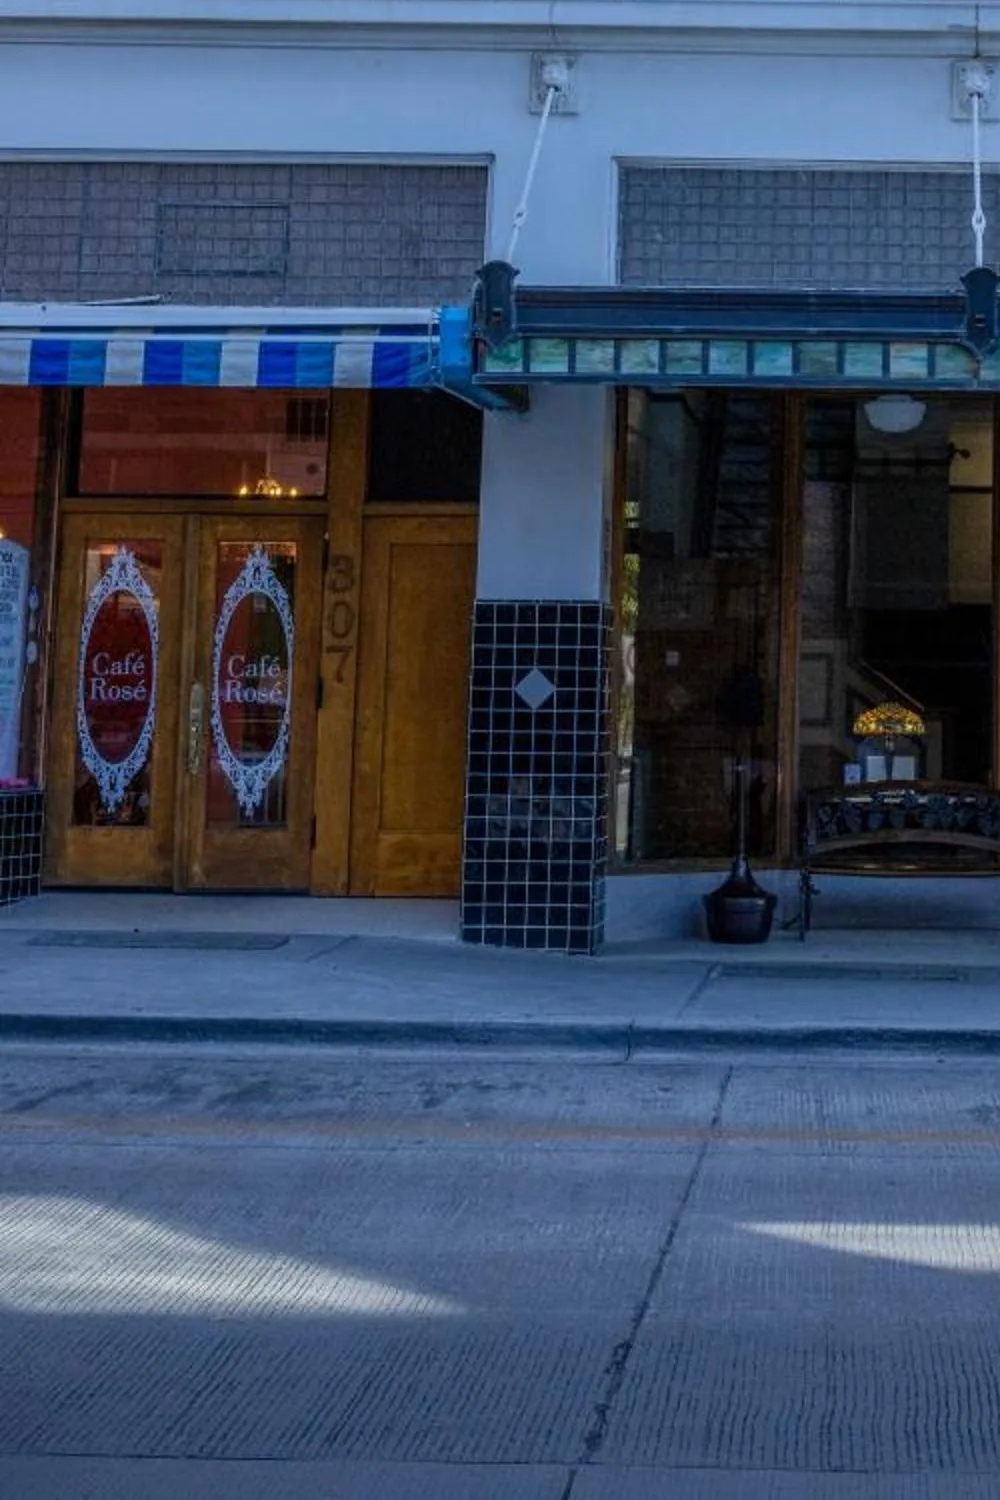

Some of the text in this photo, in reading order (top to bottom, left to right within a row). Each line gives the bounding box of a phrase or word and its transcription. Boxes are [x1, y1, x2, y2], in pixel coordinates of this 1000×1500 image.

[326, 554, 355, 684] 307
[91, 650, 146, 676] Café
[227, 654, 282, 679] Café
[90, 676, 147, 701] Rosé
[223, 679, 284, 703] Rosé
